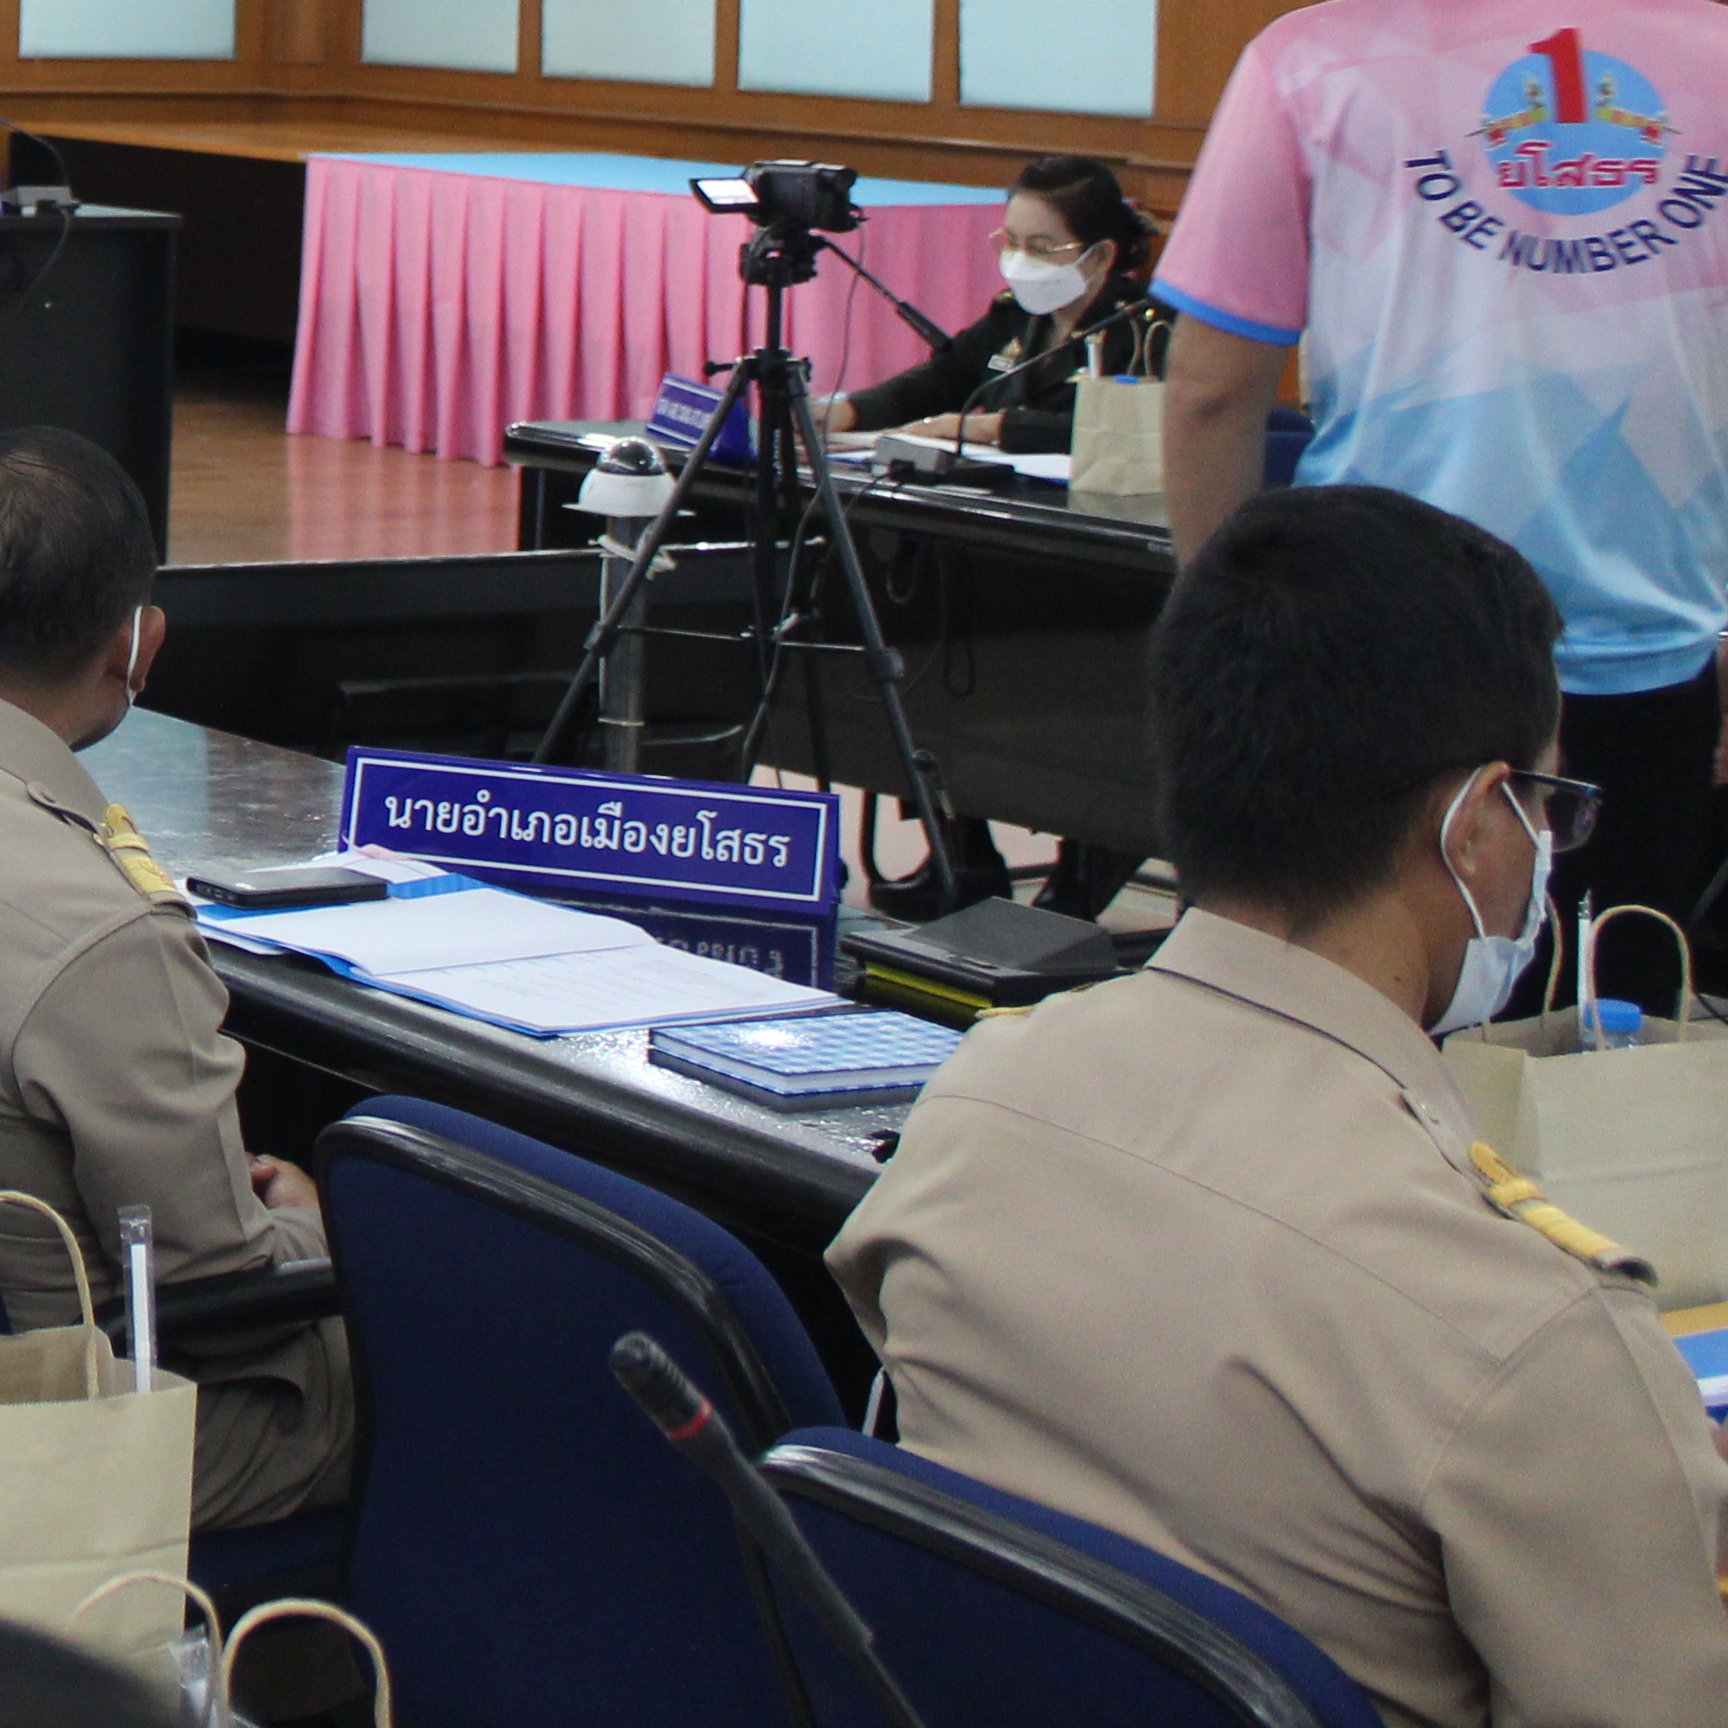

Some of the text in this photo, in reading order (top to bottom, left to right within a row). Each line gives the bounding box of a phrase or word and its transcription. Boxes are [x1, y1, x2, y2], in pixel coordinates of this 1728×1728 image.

[1527, 28, 1587, 123] 1
[1497, 140, 1660, 188] ยโสธร
[1405, 148, 1461, 201] TO
[1439, 201, 1505, 250] BE
[1499, 218, 1678, 274] NUMBER
[385, 788, 791, 869] นายอำเภอเมืองยโสธร
